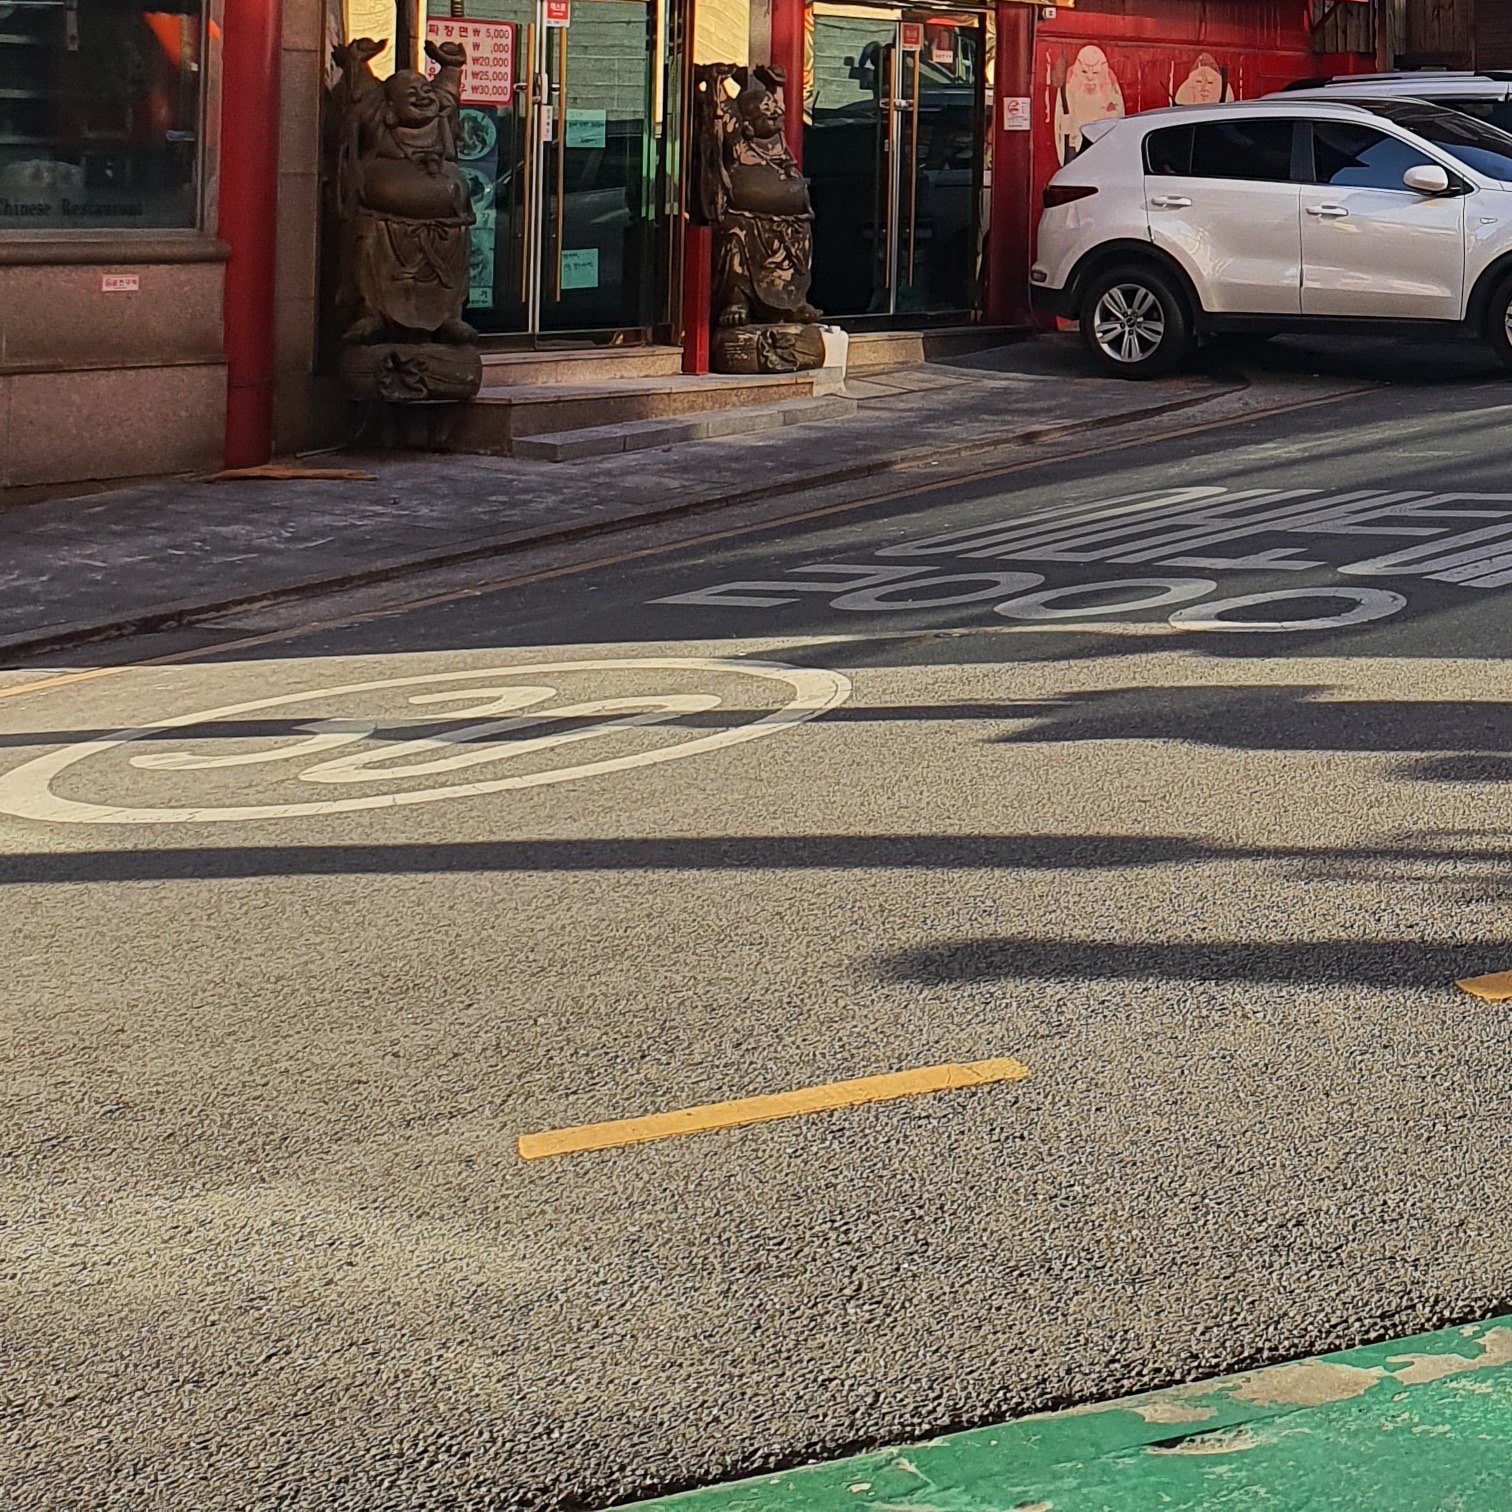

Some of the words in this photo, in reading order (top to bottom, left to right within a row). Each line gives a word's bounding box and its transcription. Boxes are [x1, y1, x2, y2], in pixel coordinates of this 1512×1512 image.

[486, 29, 510, 39] 5,000
[0, 197, 51, 216] hinese
[129, 686, 723, 784] 30
